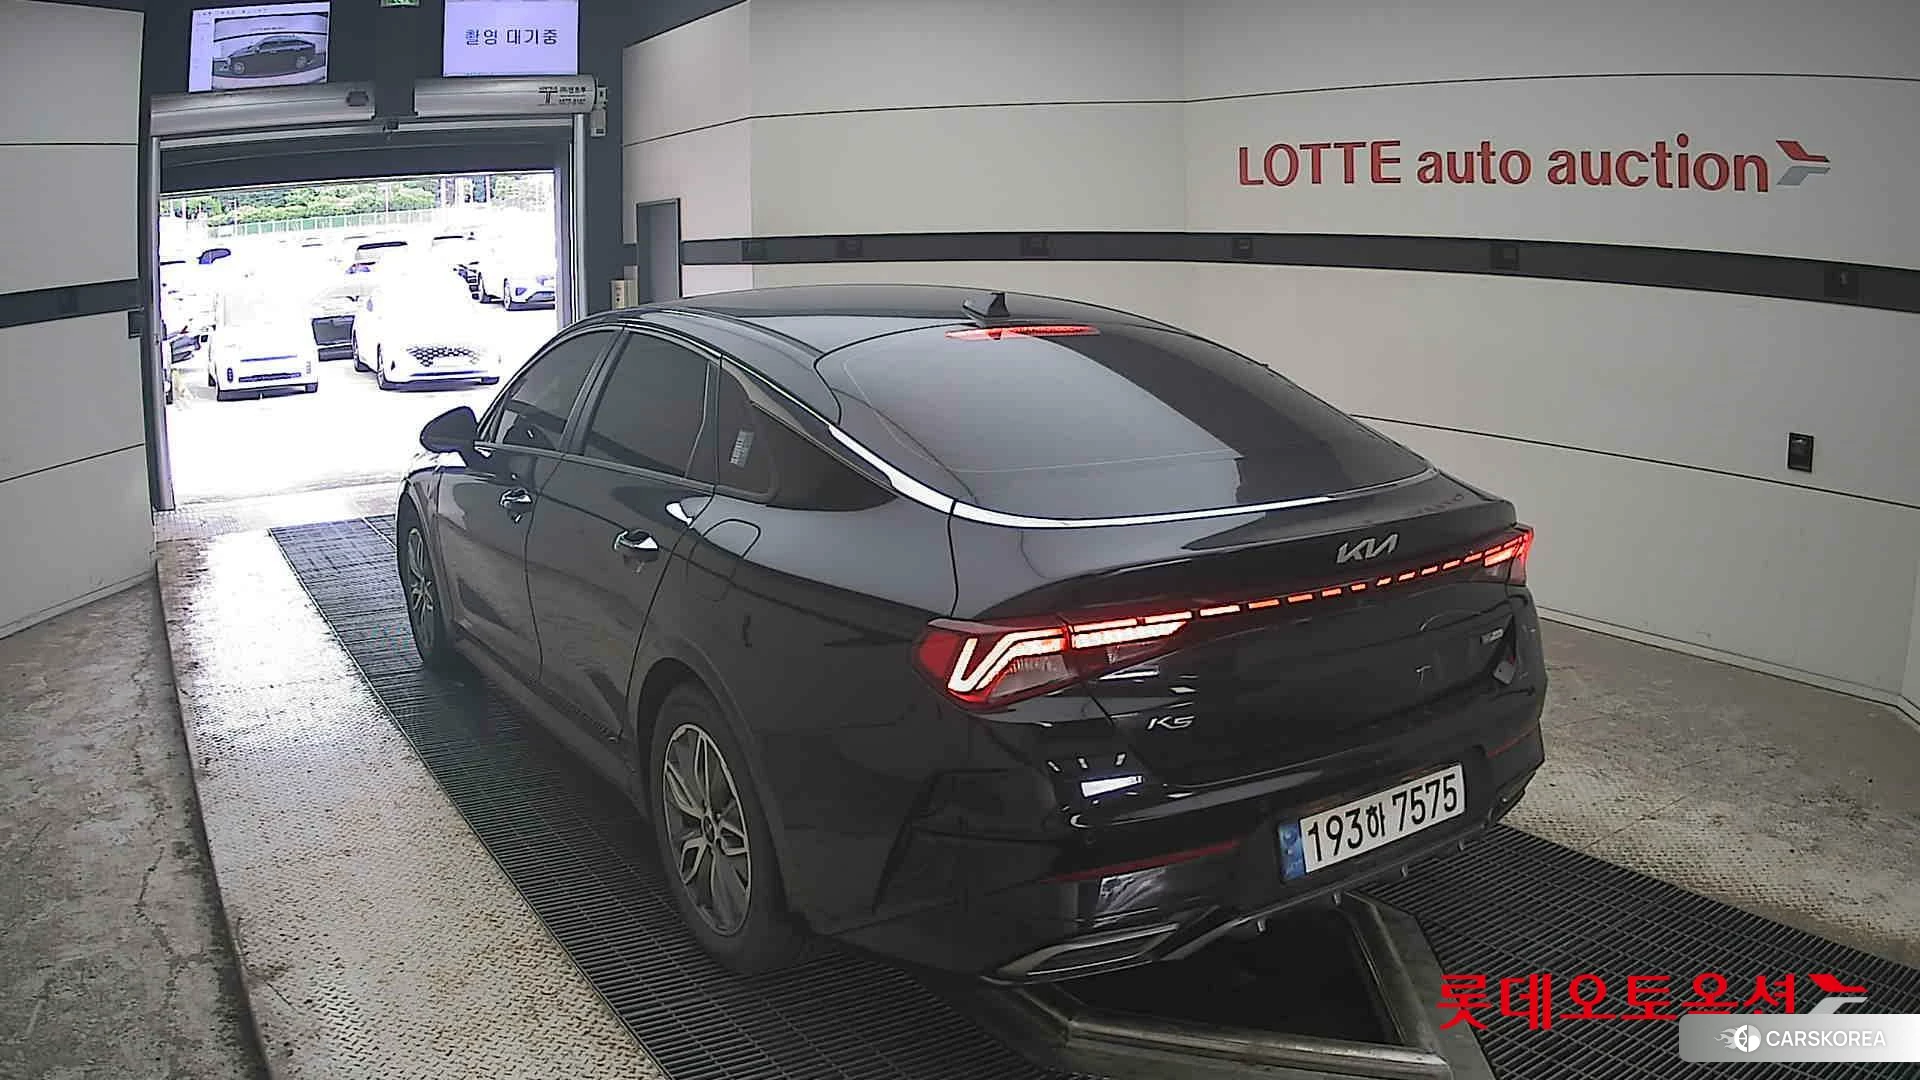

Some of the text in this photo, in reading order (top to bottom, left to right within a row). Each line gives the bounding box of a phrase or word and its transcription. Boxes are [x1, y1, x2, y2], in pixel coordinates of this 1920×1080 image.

[1239, 133, 1769, 193] LOTTE auto auction
[1147, 716, 1195, 730] K5
[1308, 774, 1457, 862] 193하 7575
